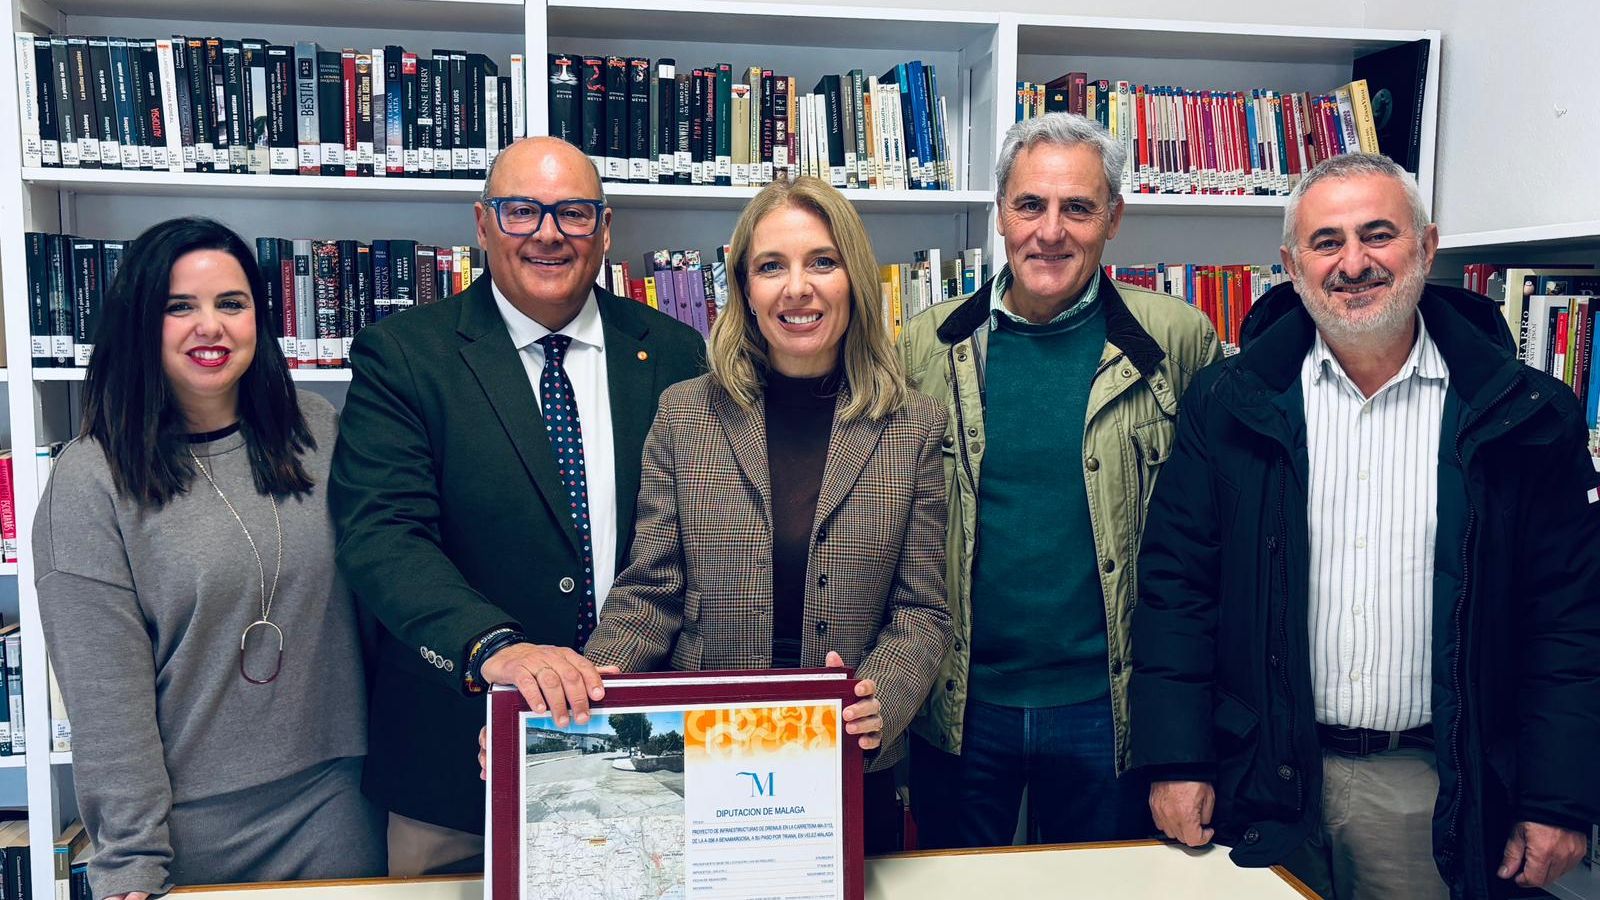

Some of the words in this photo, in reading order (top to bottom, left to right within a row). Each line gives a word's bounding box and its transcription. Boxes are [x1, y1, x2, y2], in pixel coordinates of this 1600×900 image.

[229, 68, 237, 84] JUAN
[300, 82, 314, 116] BESTIA
[855, 74, 863, 110] CORTOMETRAJE
[421, 95, 429, 118] ANNE
[151, 108, 162, 137] AUTOPSIA
[679, 121, 689, 150] CORNWELL
[454, 137, 461, 145] NO
[764, 119, 772, 157] DESPERTAR
[736, 772, 776, 798] M
[716, 808, 761, 818] DIPUTACION
[763, 807, 773, 816] DE
[774, 806, 806, 815] MALAGA
